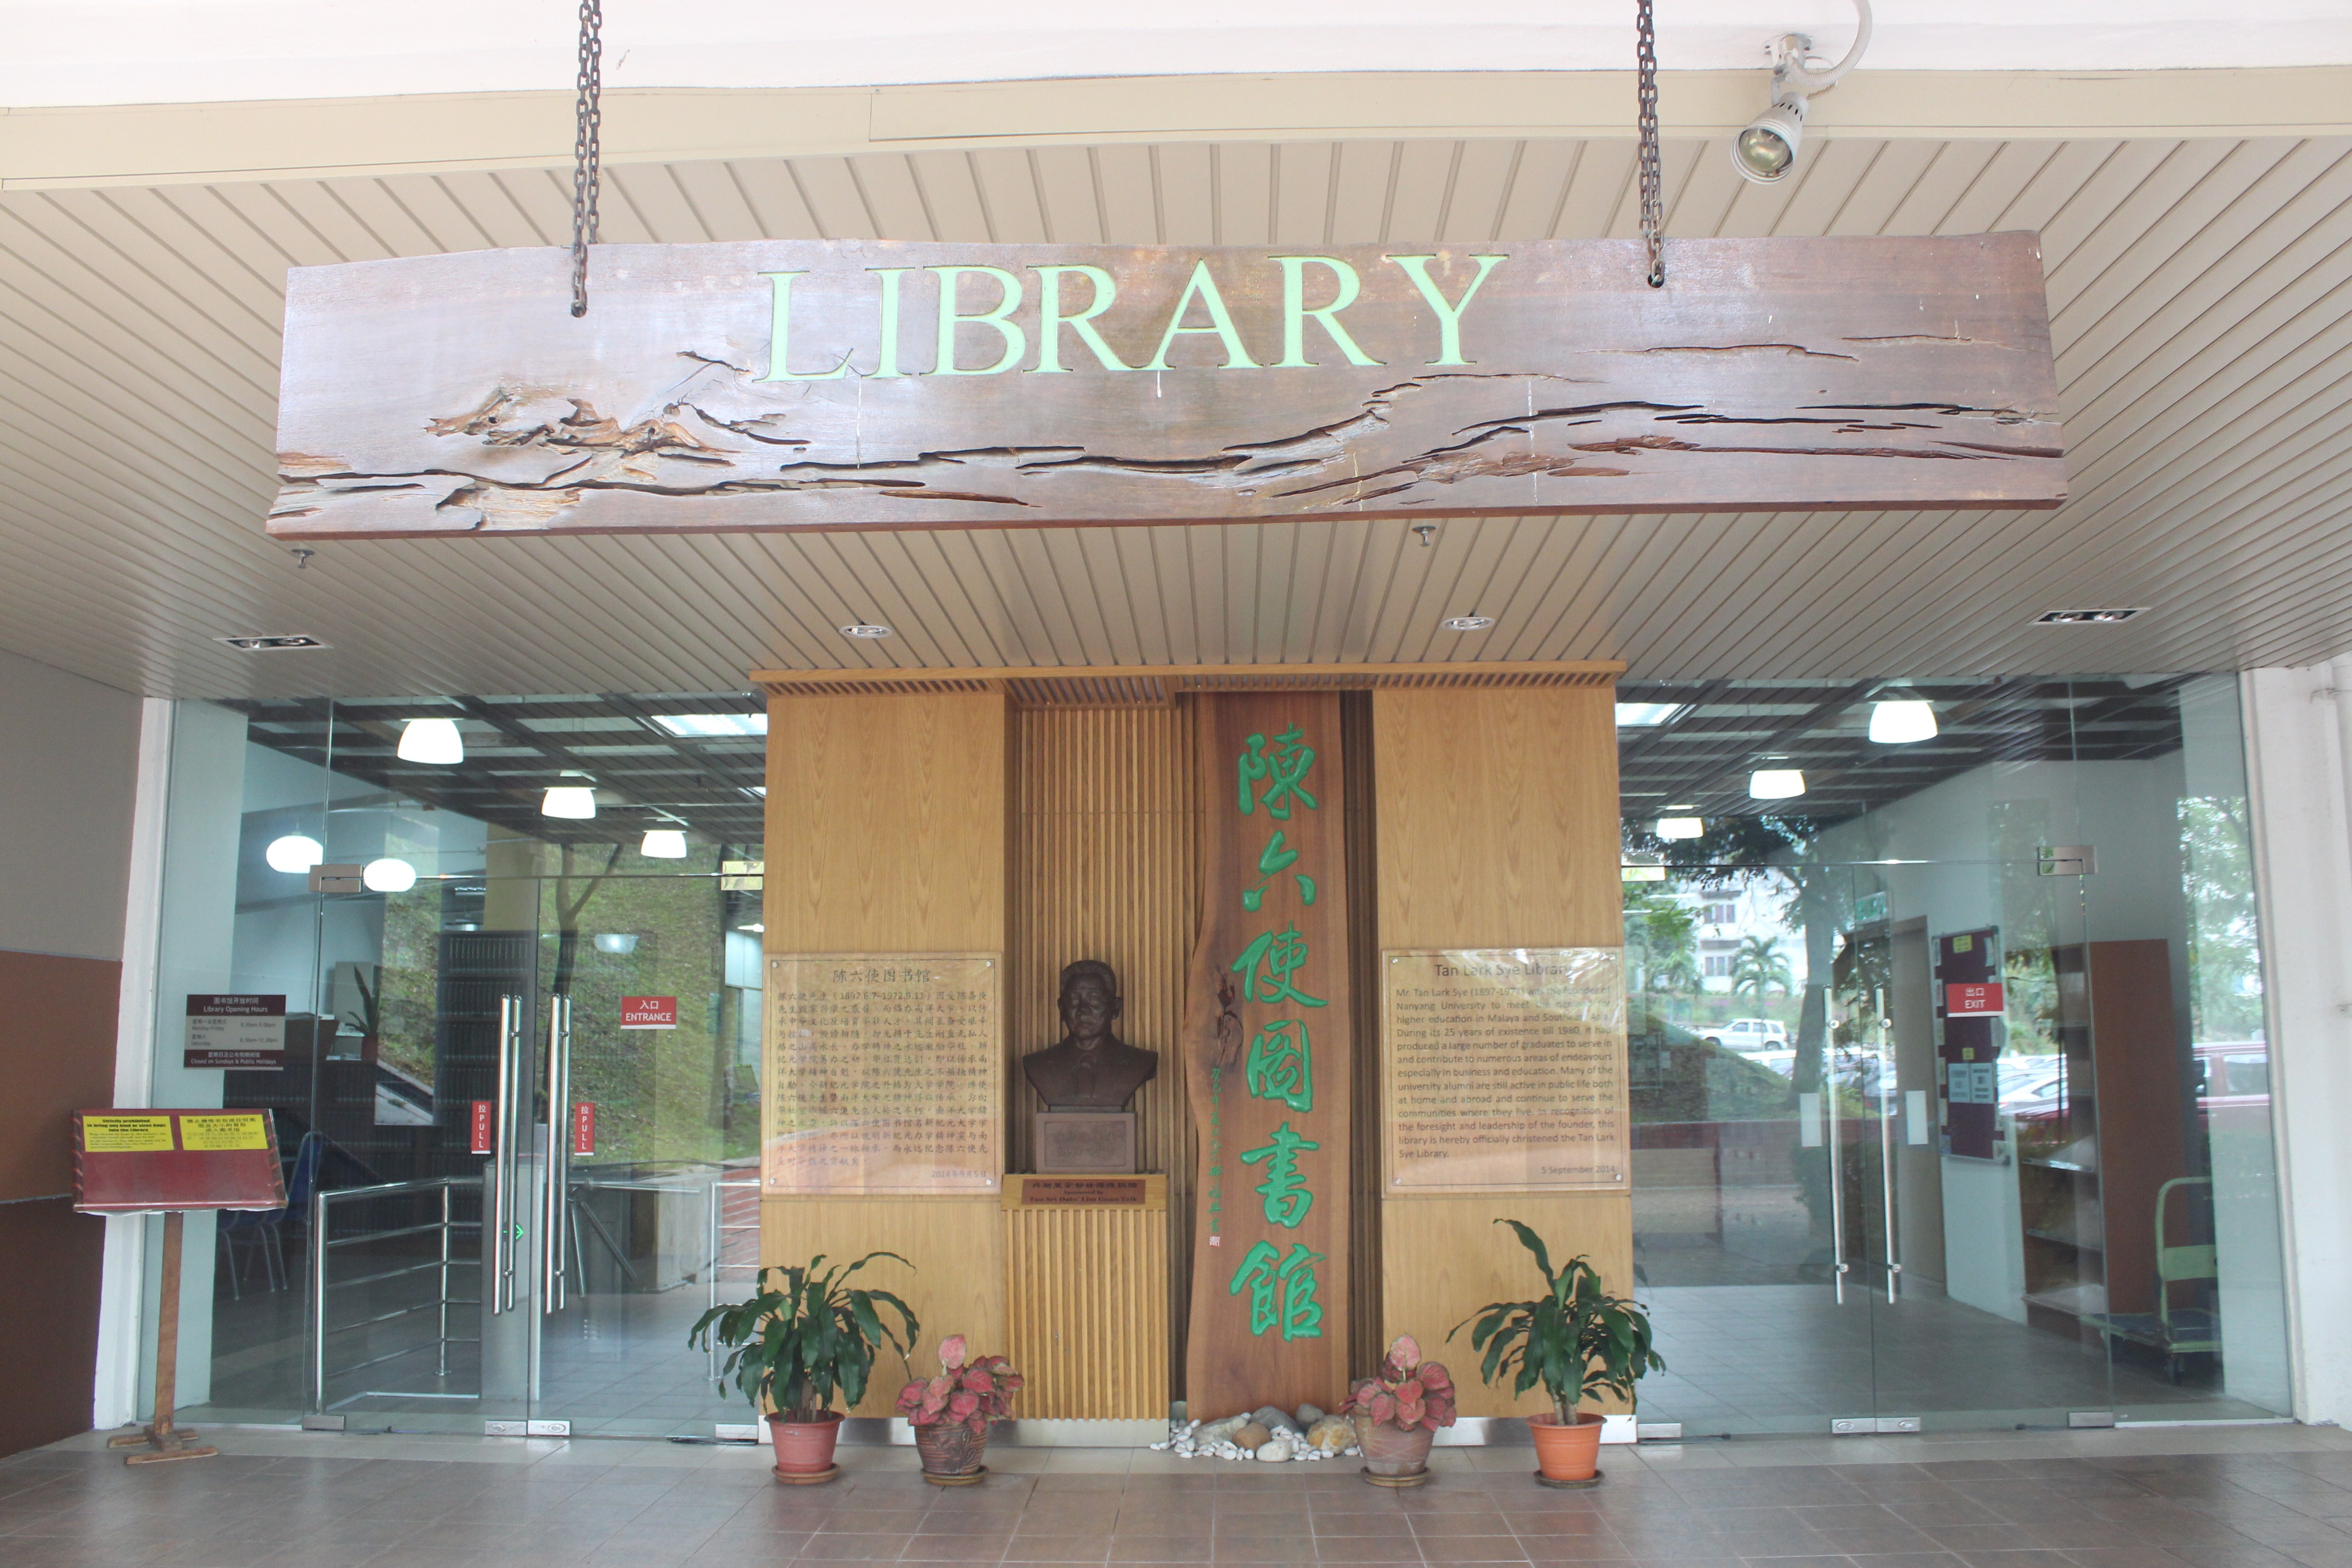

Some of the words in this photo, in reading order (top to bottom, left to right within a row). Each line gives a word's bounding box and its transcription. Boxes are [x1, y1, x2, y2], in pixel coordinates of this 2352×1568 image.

[751, 254, 1510, 383] LIBRARY
[833, 969, 931, 983] 陈六使图书馆
[1435, 964, 1459, 976] Tan
[1464, 964, 1491, 976] Lark
[1497, 964, 1519, 978] Sye
[1414, 988, 1429, 996] Tan
[1453, 988, 1468, 998] Sye
[1965, 987, 1984, 996] 出口
[639, 1000, 659, 1009] 入口
[1396, 1001, 1436, 1012] Nanyang
[1441, 1001, 1485, 1011] University
[1491, 1001, 1501, 1009] to
[1507, 1001, 1530, 1009] meet
[1965, 1000, 1985, 1009] EXIT
[626, 1013, 671, 1022] ENTRANCE
[1397, 1015, 1424, 1025] higher
[1429, 1014, 1473, 1023] education
[1476, 1014, 1484, 1023] in
[1488, 1014, 1519, 1024] Malaya
[1523, 1014, 1540, 1022] and
[1397, 1028, 1426, 1039] During
[1430, 1028, 1441, 1036] its
[1445, 1028, 1455, 1036] 25
[1485, 1027, 1494, 1036] of
[1498, 1027, 1539, 1035] existence
[1558, 1026, 1581, 1036] 1980,
[1397, 1042, 1440, 1052] produced
[1449, 1041, 1471, 1052] large
[1473, 1041, 1507, 1049] number
[1510, 1041, 1519, 1049] of
[1521, 1040, 1564, 1051] graduates
[1567, 1040, 1576, 1048] to
[1604, 1039, 1612, 1048] in
[1398, 1055, 1414, 1063] and
[1416, 1054, 1463, 1063] contribute
[1465, 1054, 1475, 1063] to
[1550, 1054, 1559, 1062] of
[1562, 1053, 1612, 1062] endeavours
[1398, 1068, 1441, 1079] especially
[1443, 1068, 1451, 1077] in
[1453, 1068, 1490, 1076] business
[1493, 1068, 1510, 1076] and
[1512, 1067, 1558, 1076] education.
[1560, 1067, 1585, 1077] Many
[1588, 1066, 1596, 1075] of
[1598, 1066, 1613, 1074] the
[1398, 1082, 1441, 1093] university
[1444, 1082, 1474, 1090] alumni
[1493, 1081, 1508, 1089] still
[1510, 1081, 1536, 1089] active
[1538, 1081, 1546, 1089] in
[1548, 1080, 1574, 1091] public
[1577, 1080, 1590, 1088] life
[1593, 1080, 1613, 1088] both
[1399, 1096, 1406, 1104] at
[1411, 1095, 1436, 1104] home
[1441, 1095, 1457, 1103] and
[1461, 1095, 1492, 1103] abroad
[1496, 1094, 1513, 1103] and
[1516, 1094, 1555, 1102] continue
[1558, 1094, 1568, 1102] to
[1599, 1093, 1613, 1102] the
[479, 1104, 486, 1113] 拉
[581, 1106, 588, 1114] 拉
[1399, 1108, 1456, 1117] communities
[1460, 1108, 1488, 1117] where
[1492, 1107, 1512, 1118] they
[1516, 1107, 1534, 1116] live.
[1539, 1107, 1547, 1116] In
[1551, 1107, 1601, 1117] recognition
[1605, 1107, 1614, 1115] of
[1399, 1122, 1413, 1131] the
[1417, 1122, 1455, 1132] foresight
[1460, 1122, 1476, 1130] and
[1479, 1121, 1525, 1132] leadership
[1528, 1121, 1537, 1129] of
[1540, 1121, 1555, 1129] the
[1558, 1120, 1595, 1130] founder,
[1598, 1120, 1615, 1128] this
[1399, 1136, 1427, 1146] library
[1430, 1136, 1436, 1144] is
[1439, 1135, 1470, 1146] hereby
[1473, 1135, 1509, 1145] officially
[1512, 1134, 1559, 1143] christened
[1561, 1134, 1576, 1142] the
[1579, 1134, 1593, 1142] Tan
[1597, 1133, 1615, 1142] Lark
[1399, 1150, 1414, 1159] Sye
[1417, 1149, 1449, 1159] Library.
[931, 1170, 986, 1178] 2014年9月5日
[1549, 1165, 1593, 1176] September
[1597, 1165, 1616, 1173] 2014
